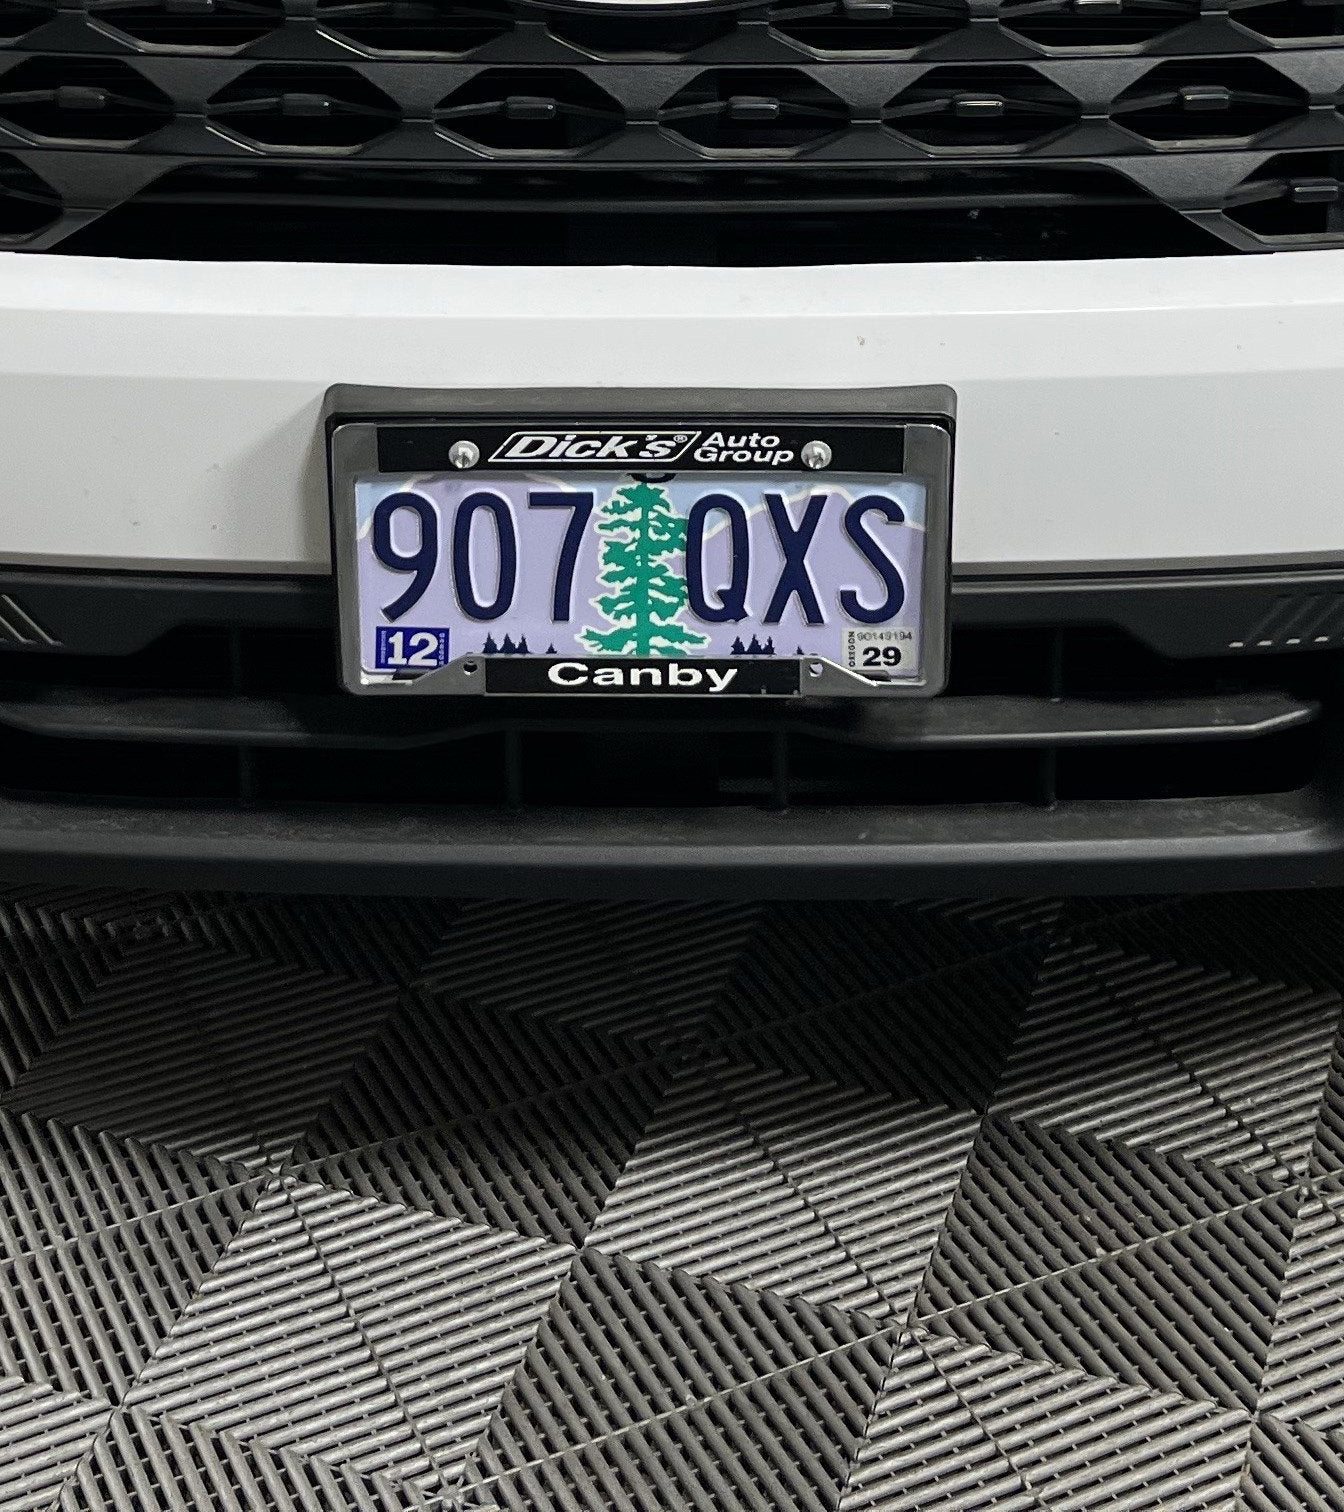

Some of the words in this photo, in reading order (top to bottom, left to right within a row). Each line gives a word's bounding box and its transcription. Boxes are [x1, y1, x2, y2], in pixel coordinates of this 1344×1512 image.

[702, 431, 781, 448] Auto
[693, 446, 794, 466] Group
[371, 490, 595, 623] 907
[684, 491, 906, 626] QXS
[387, 631, 438, 666] 12
[862, 646, 902, 667] 29
[547, 662, 738, 692] Canby
